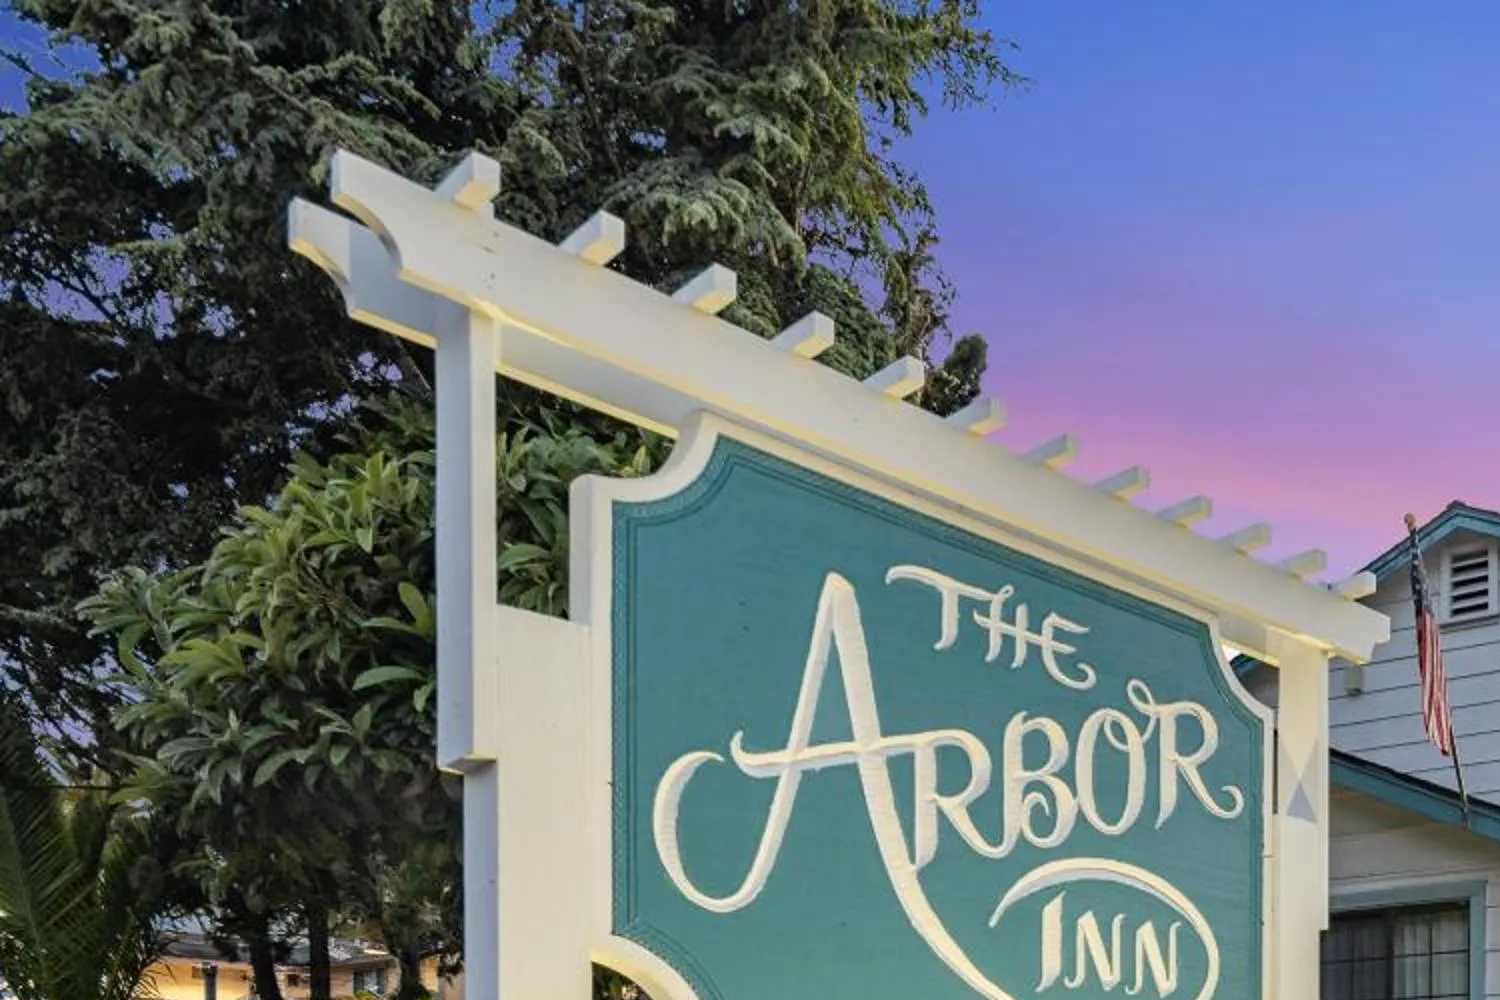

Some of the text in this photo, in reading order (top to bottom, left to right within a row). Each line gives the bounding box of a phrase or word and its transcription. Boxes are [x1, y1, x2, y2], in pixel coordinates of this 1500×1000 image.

[886, 565, 1096, 690] THE
[653, 572, 1244, 915] ARBOR
[1035, 892, 1182, 999] INN
